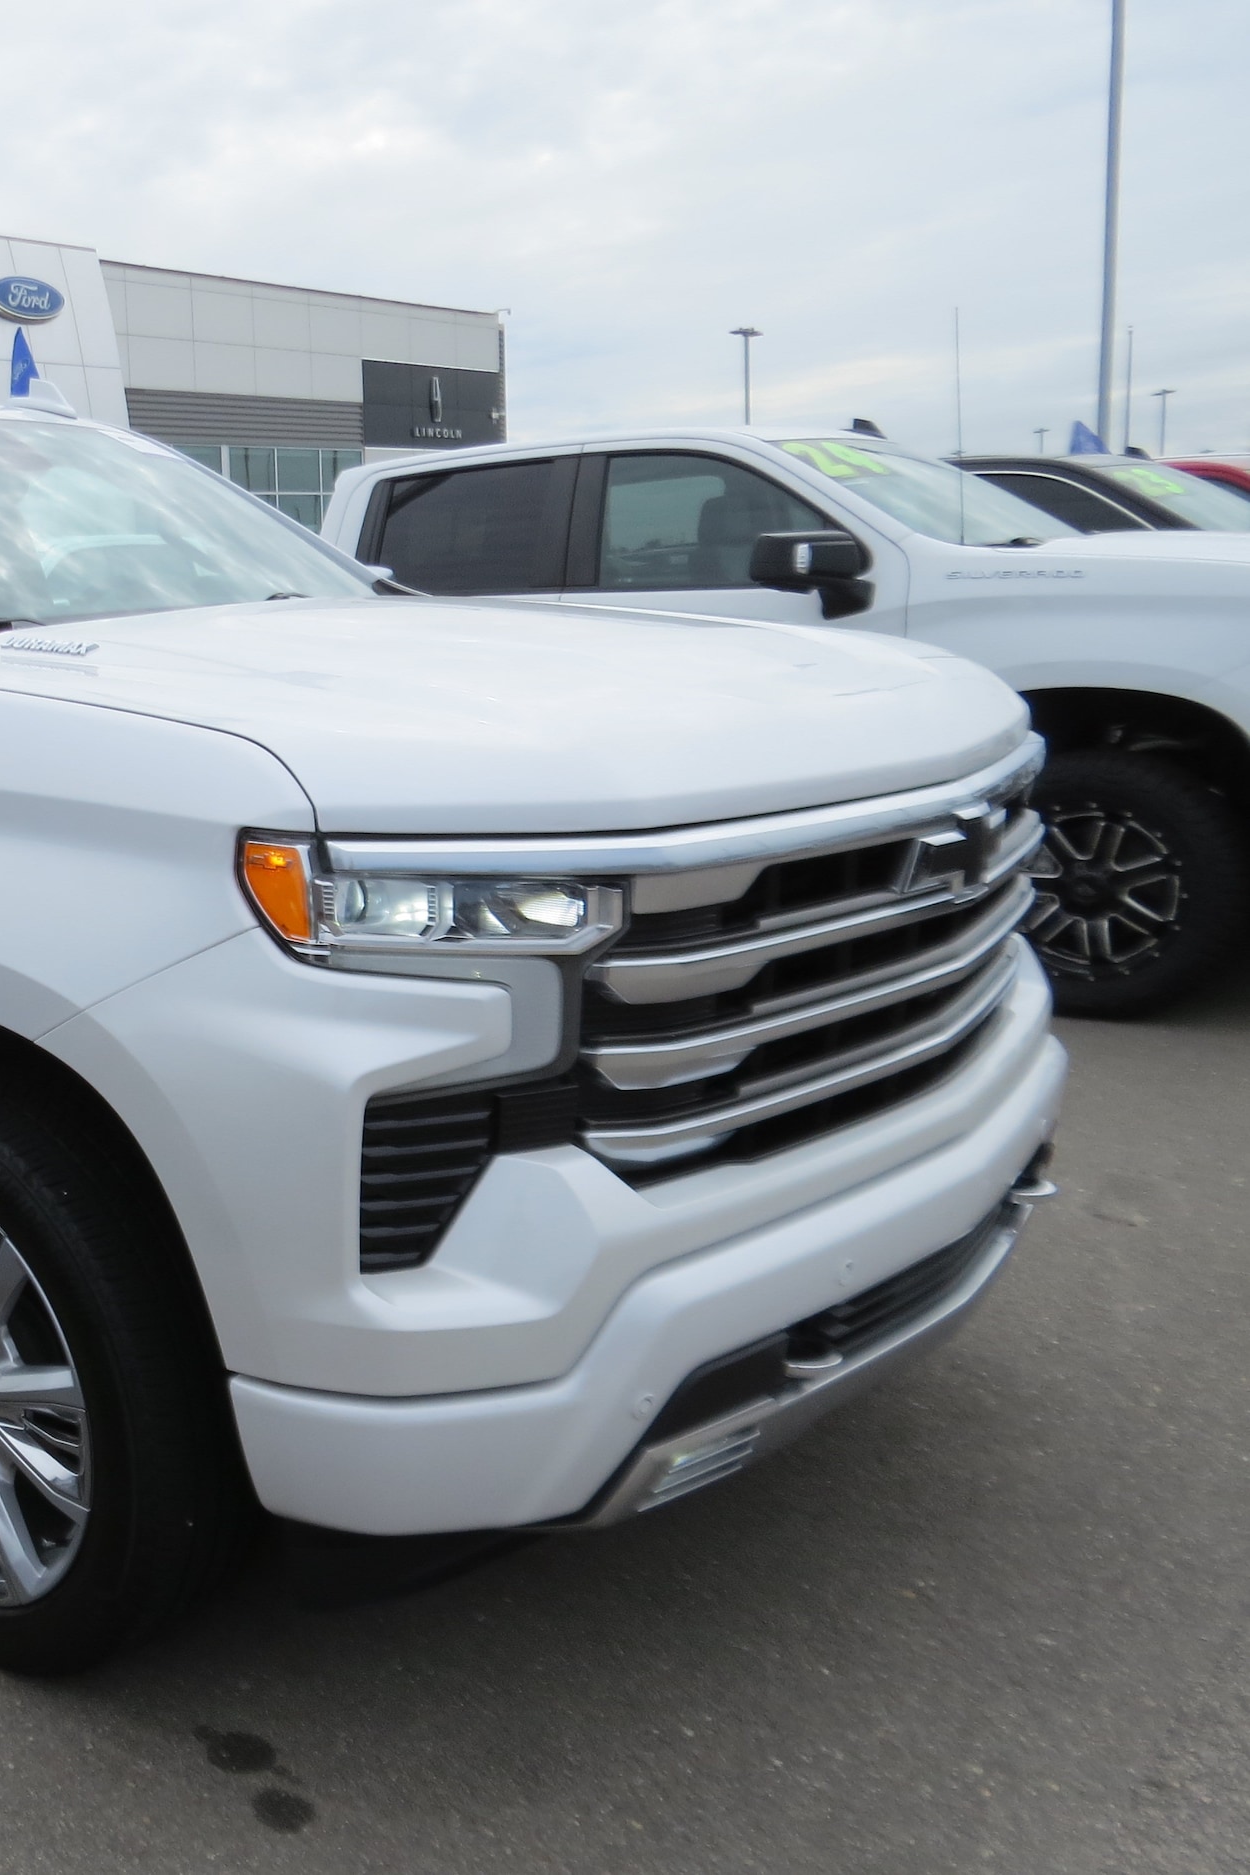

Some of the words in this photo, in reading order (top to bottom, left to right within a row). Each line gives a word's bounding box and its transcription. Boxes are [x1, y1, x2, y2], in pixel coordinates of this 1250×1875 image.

[8, 282, 51, 310] Ford
[414, 426, 463, 439] LINCOLN
[0, 637, 87, 656] DURAMAX
